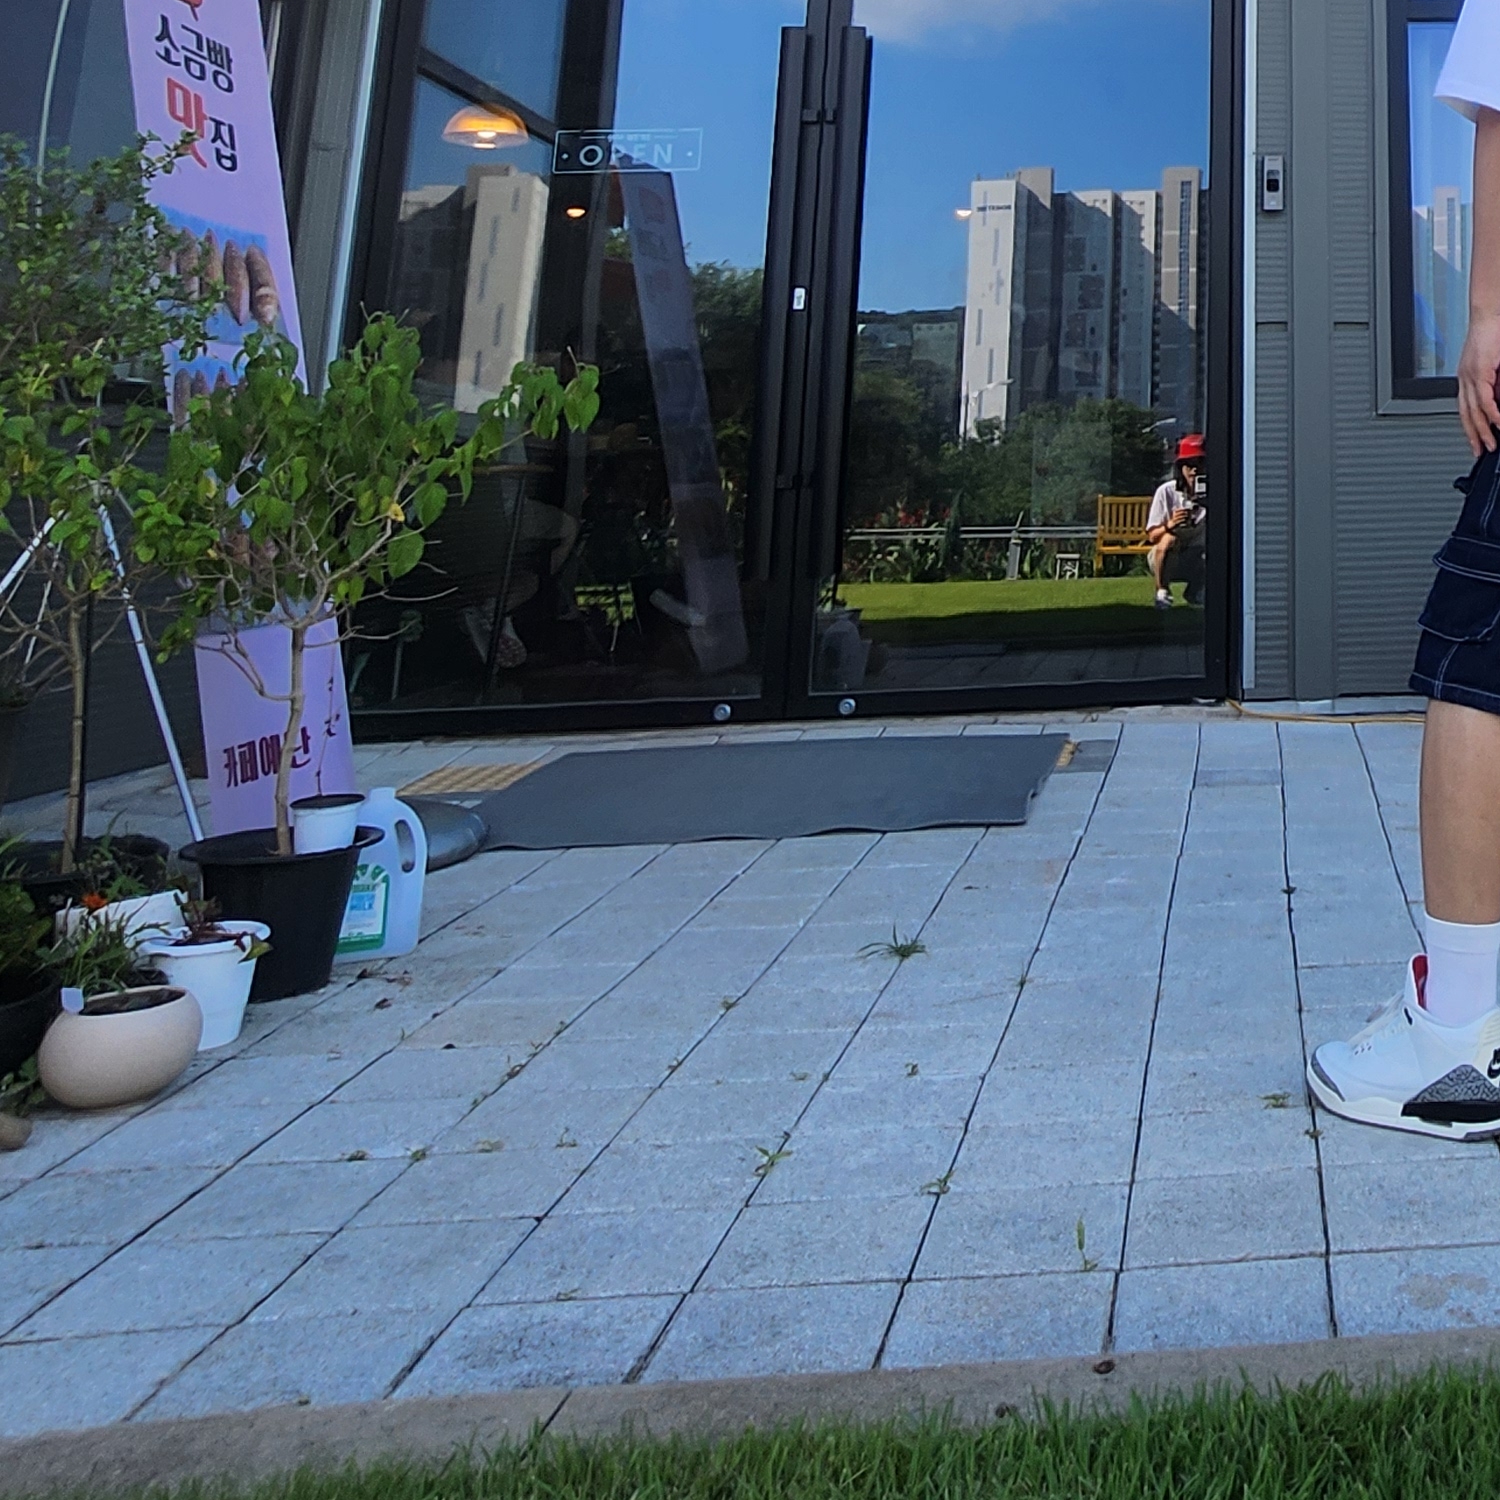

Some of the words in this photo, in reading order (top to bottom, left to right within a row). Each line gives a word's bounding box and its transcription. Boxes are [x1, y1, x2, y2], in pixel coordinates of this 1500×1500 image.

[155, 14, 235, 94] 소금빵
[166, 76, 238, 173] 맛집
[579, 143, 673, 167] OPEN
